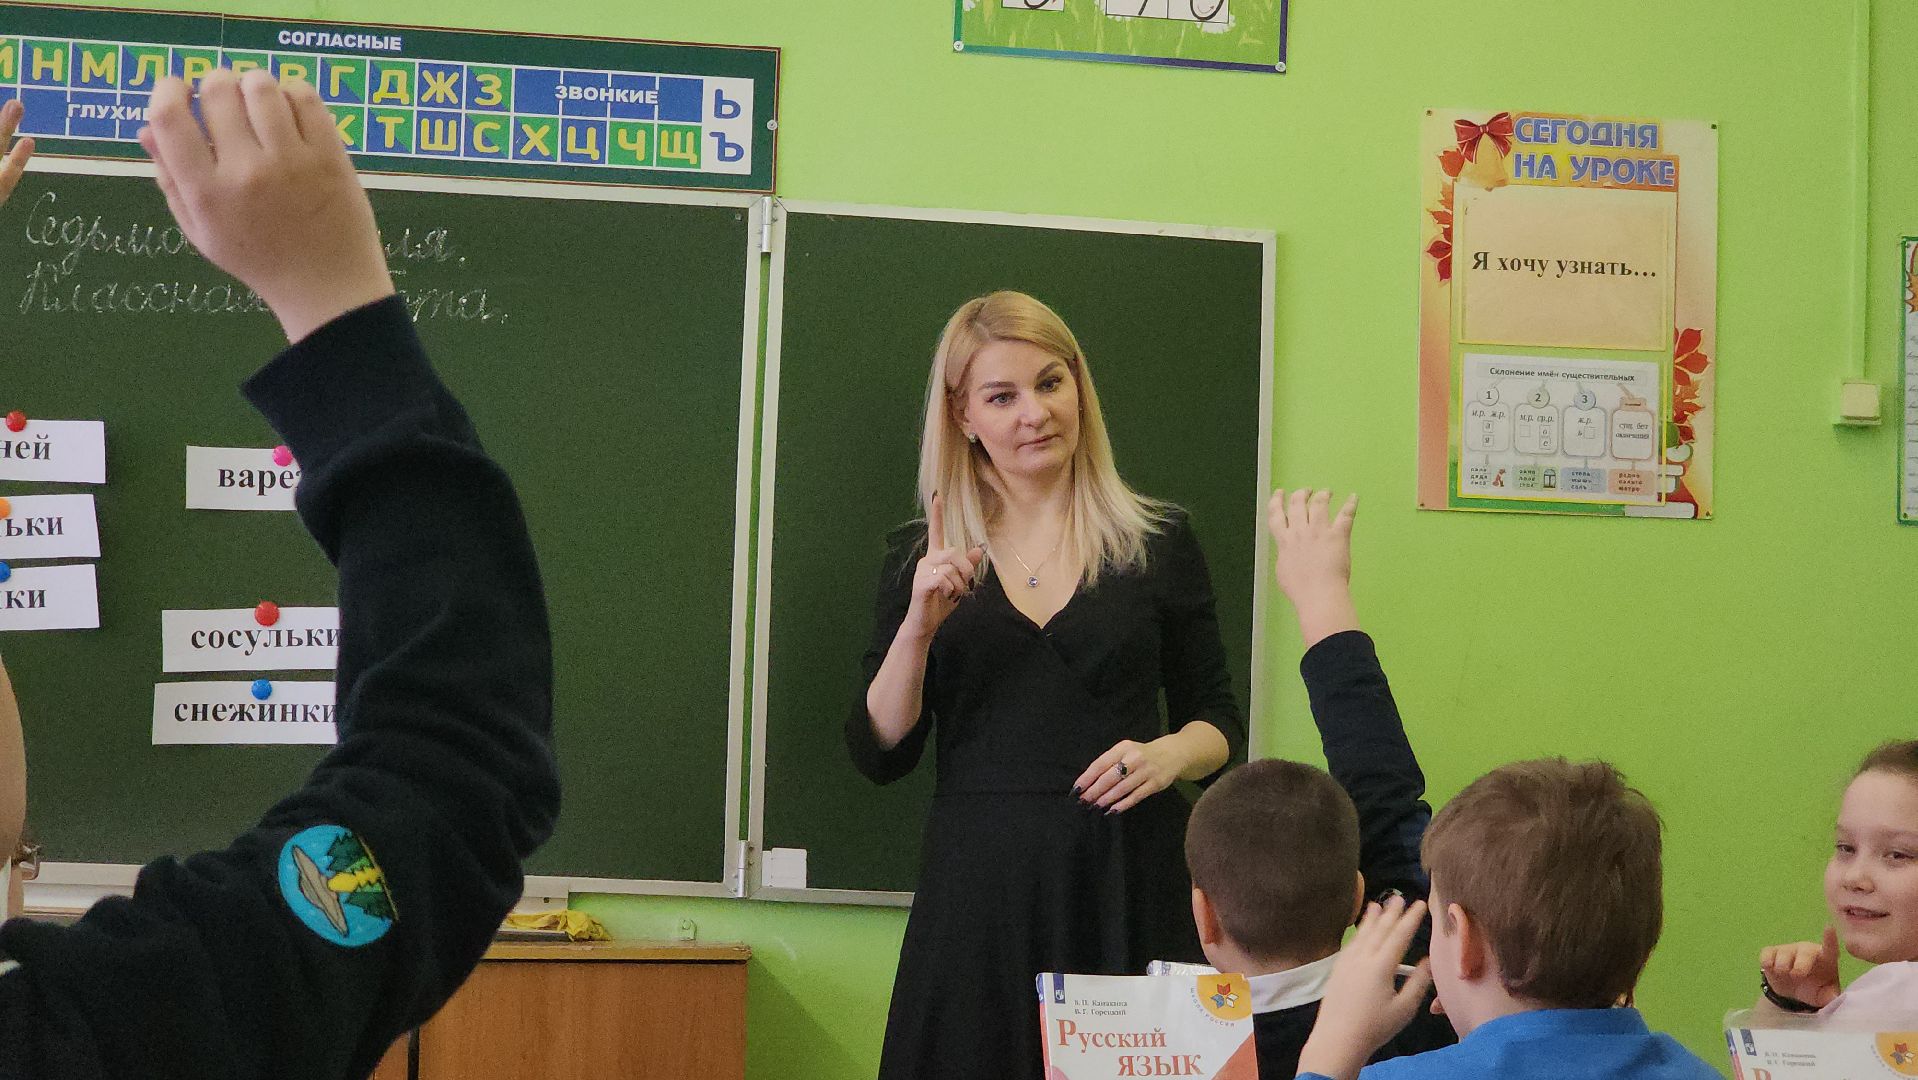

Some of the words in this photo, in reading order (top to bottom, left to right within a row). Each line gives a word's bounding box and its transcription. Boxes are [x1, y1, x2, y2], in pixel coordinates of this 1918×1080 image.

[278, 31, 402, 51] СОГЛАСНЫЕ
[31, 48, 63, 82] Н
[81, 51, 115, 84] М
[330, 66, 355, 97] Г
[373, 69, 410, 105] Д
[421, 71, 459, 104] Ж
[475, 74, 502, 106] З
[555, 84, 659, 104] ЗВОНКИЕ
[376, 116, 405, 148] Т
[420, 118, 457, 151] Ш
[473, 121, 501, 154] С
[520, 123, 550, 156] Х
[566, 126, 599, 160] Ц
[617, 129, 645, 161] Ч
[660, 130, 697, 164] Щ
[1514, 117, 1659, 149] СЕГОДНЯ
[1513, 153, 1557, 181] НА
[1569, 155, 1675, 186] УРОКЕ
[1471, 251, 1490, 271] Я
[1498, 256, 1549, 278] хочу
[1489, 367, 1535, 377] Склонение
[1561, 372, 1635, 381] существительных
[1485, 391, 1493, 400] 1
[1535, 393, 1542, 402] 2
[1581, 394, 1589, 404] 3
[190, 628, 340, 656] сосульки
[174, 703, 337, 723] снежинки
[1056, 1018, 1167, 1053] Русский
